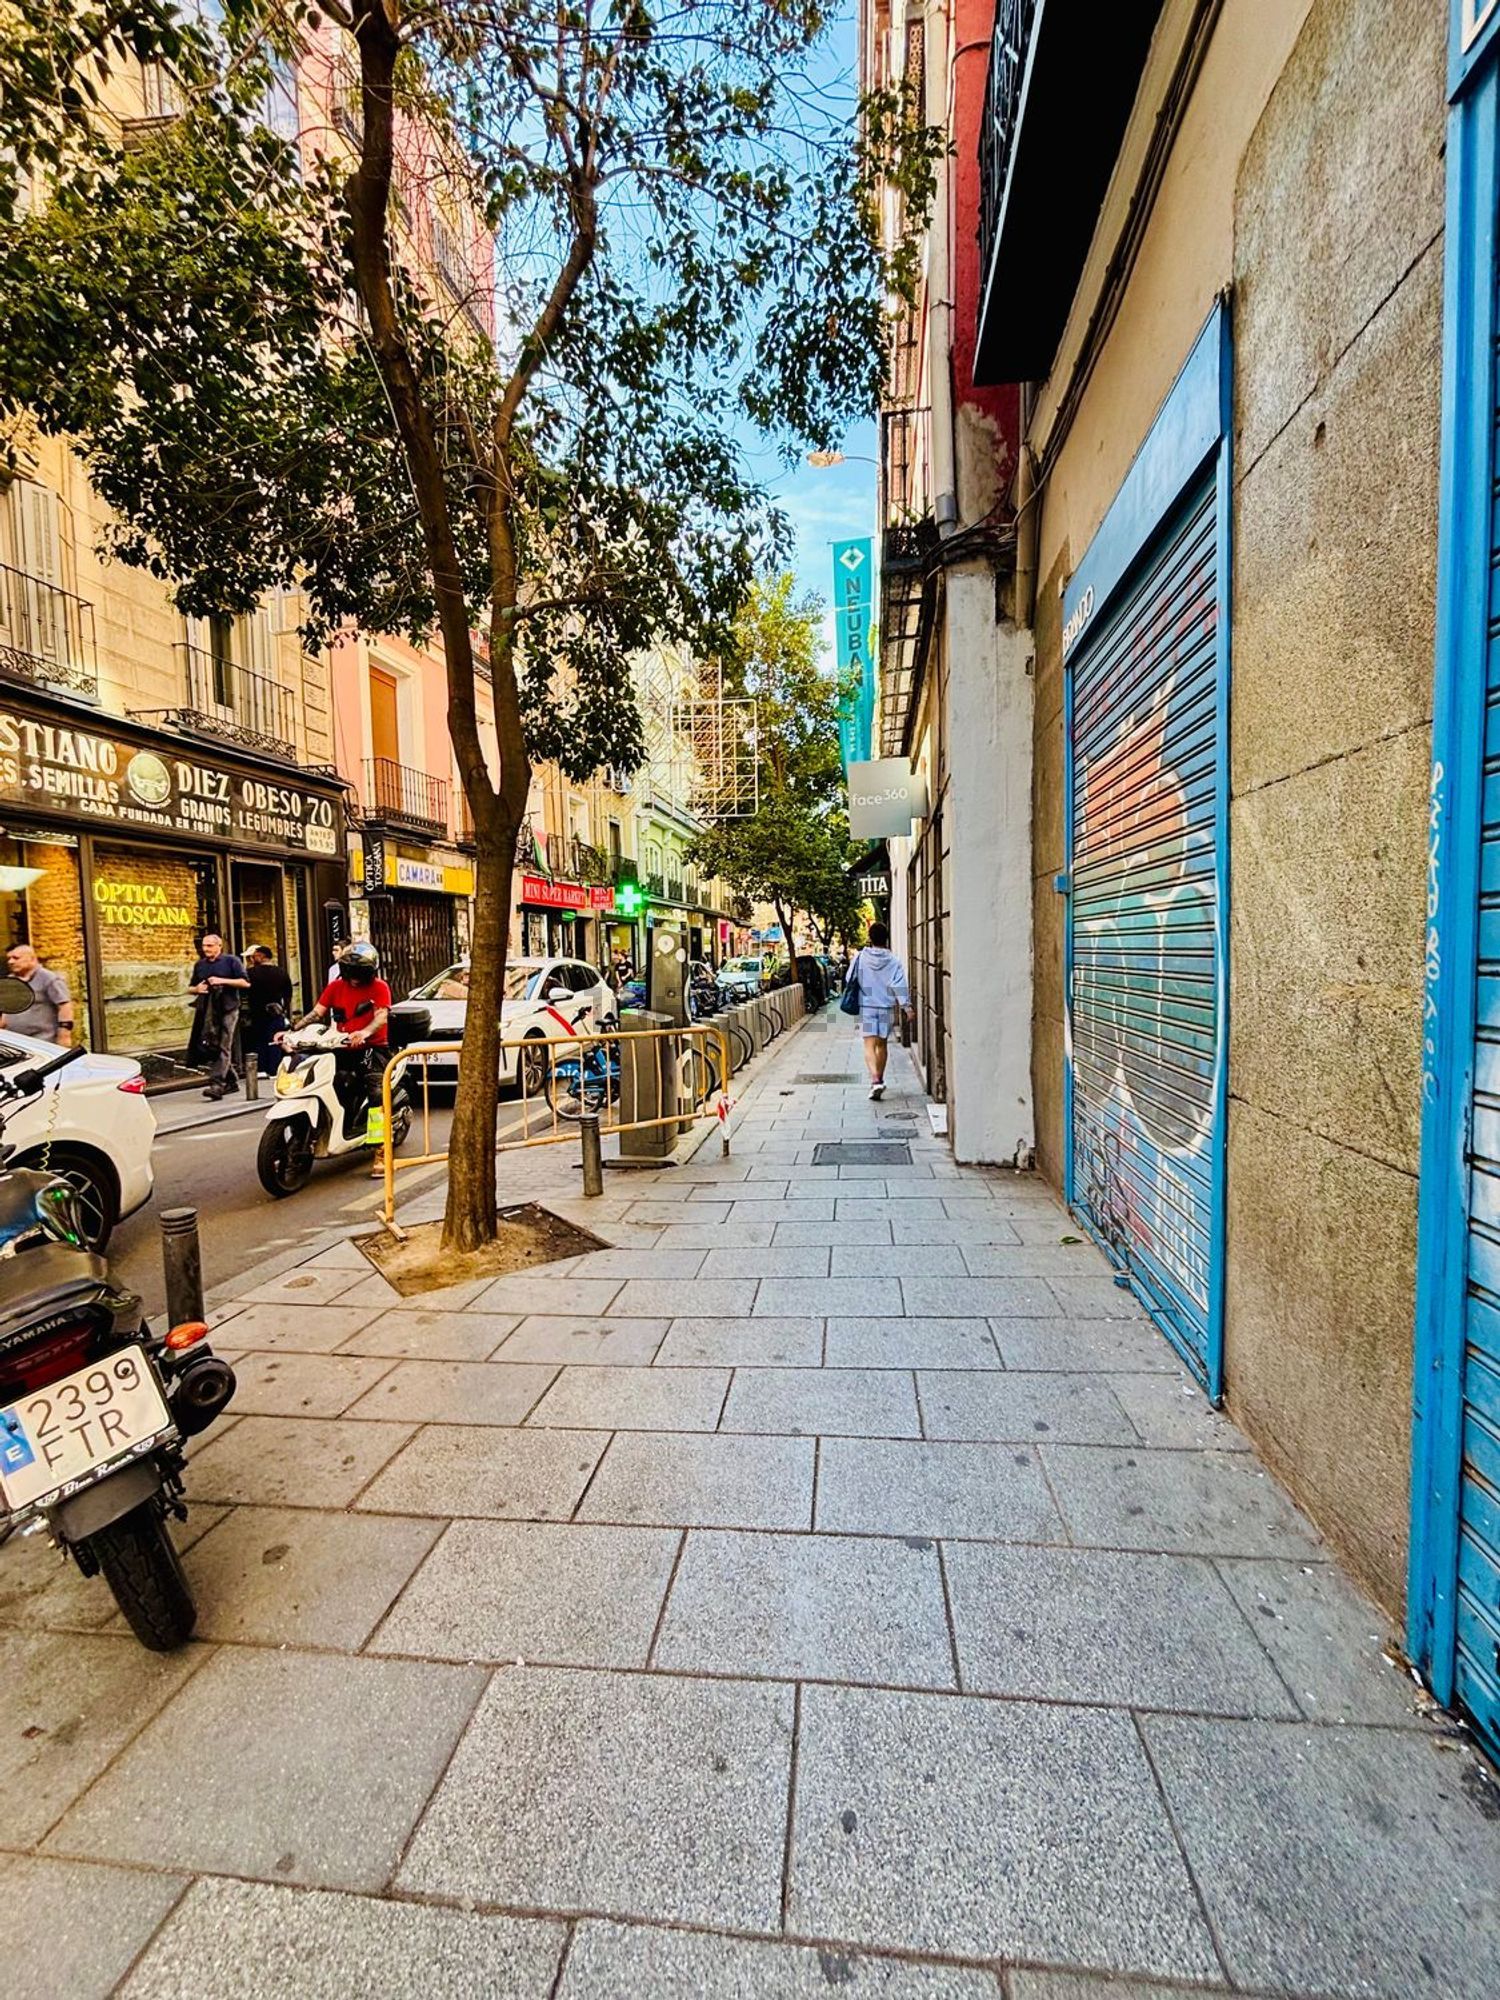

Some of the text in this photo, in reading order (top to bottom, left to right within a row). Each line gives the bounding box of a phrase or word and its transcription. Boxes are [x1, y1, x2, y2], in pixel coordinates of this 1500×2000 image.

[1063, 584, 1094, 658] BRANDO
[29, 764, 120, 804] SEMILLAS
[176, 762, 232, 803] DIEZ
[242, 780, 302, 818] OBESO
[306, 796, 332, 827] 70
[80, 799, 116, 817] CASA
[119, 806, 173, 827] FUNDADA
[176, 817, 190, 830] EN
[239, 810, 303, 839] LEGUMBRES
[373, 841, 382, 887] TOSCANA
[398, 864, 436, 887] CAMARA
[94, 878, 168, 904] ÓPTICA
[101, 905, 191, 925] TOSCANA
[2, 1317, 67, 1349] YAMAHA
[27, 1358, 141, 1439] 2399
[5, 1443, 25, 1462] E
[41, 1409, 132, 1472] FTR
